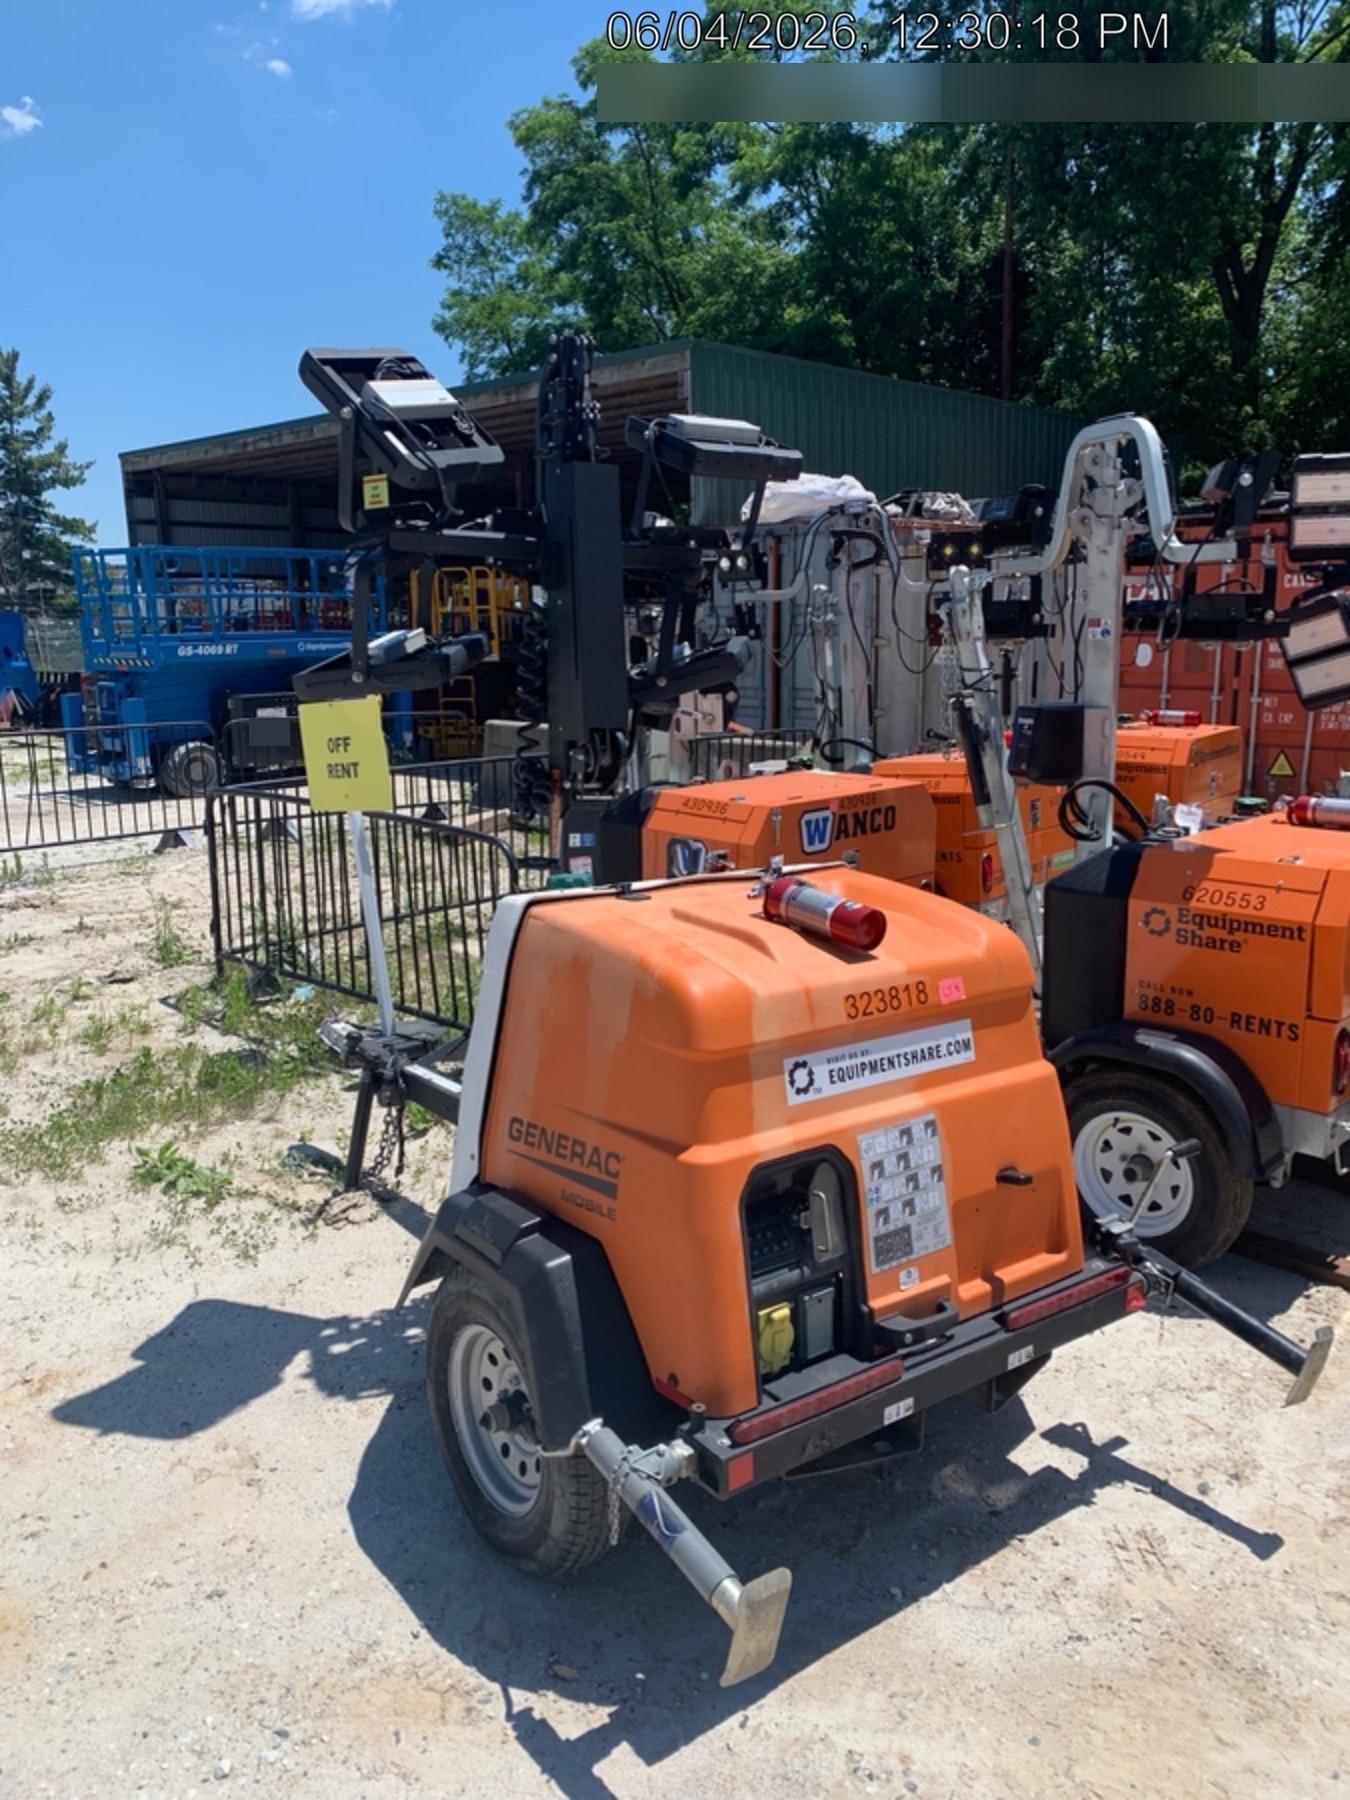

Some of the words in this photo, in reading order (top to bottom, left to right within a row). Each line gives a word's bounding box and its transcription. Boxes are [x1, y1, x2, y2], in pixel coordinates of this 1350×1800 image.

[225, 643, 239, 655] RT
[327, 736, 352, 754] OFF
[326, 763, 360, 779] RENT
[681, 797, 728, 816] 430936
[802, 805, 897, 852] WANCO
[1182, 885, 1267, 912] 620553
[1176, 906, 1307, 943] Equipment
[1175, 928, 1243, 953] Share
[845, 980, 929, 1020] 323818
[1138, 980, 1166, 993] CALL
[1170, 985, 1195, 997] NOW
[828, 1037, 972, 1085] EQUIPMENTSHARE.COM
[508, 1116, 621, 1179] GENERAC
[560, 1189, 617, 1221] MOBILE
